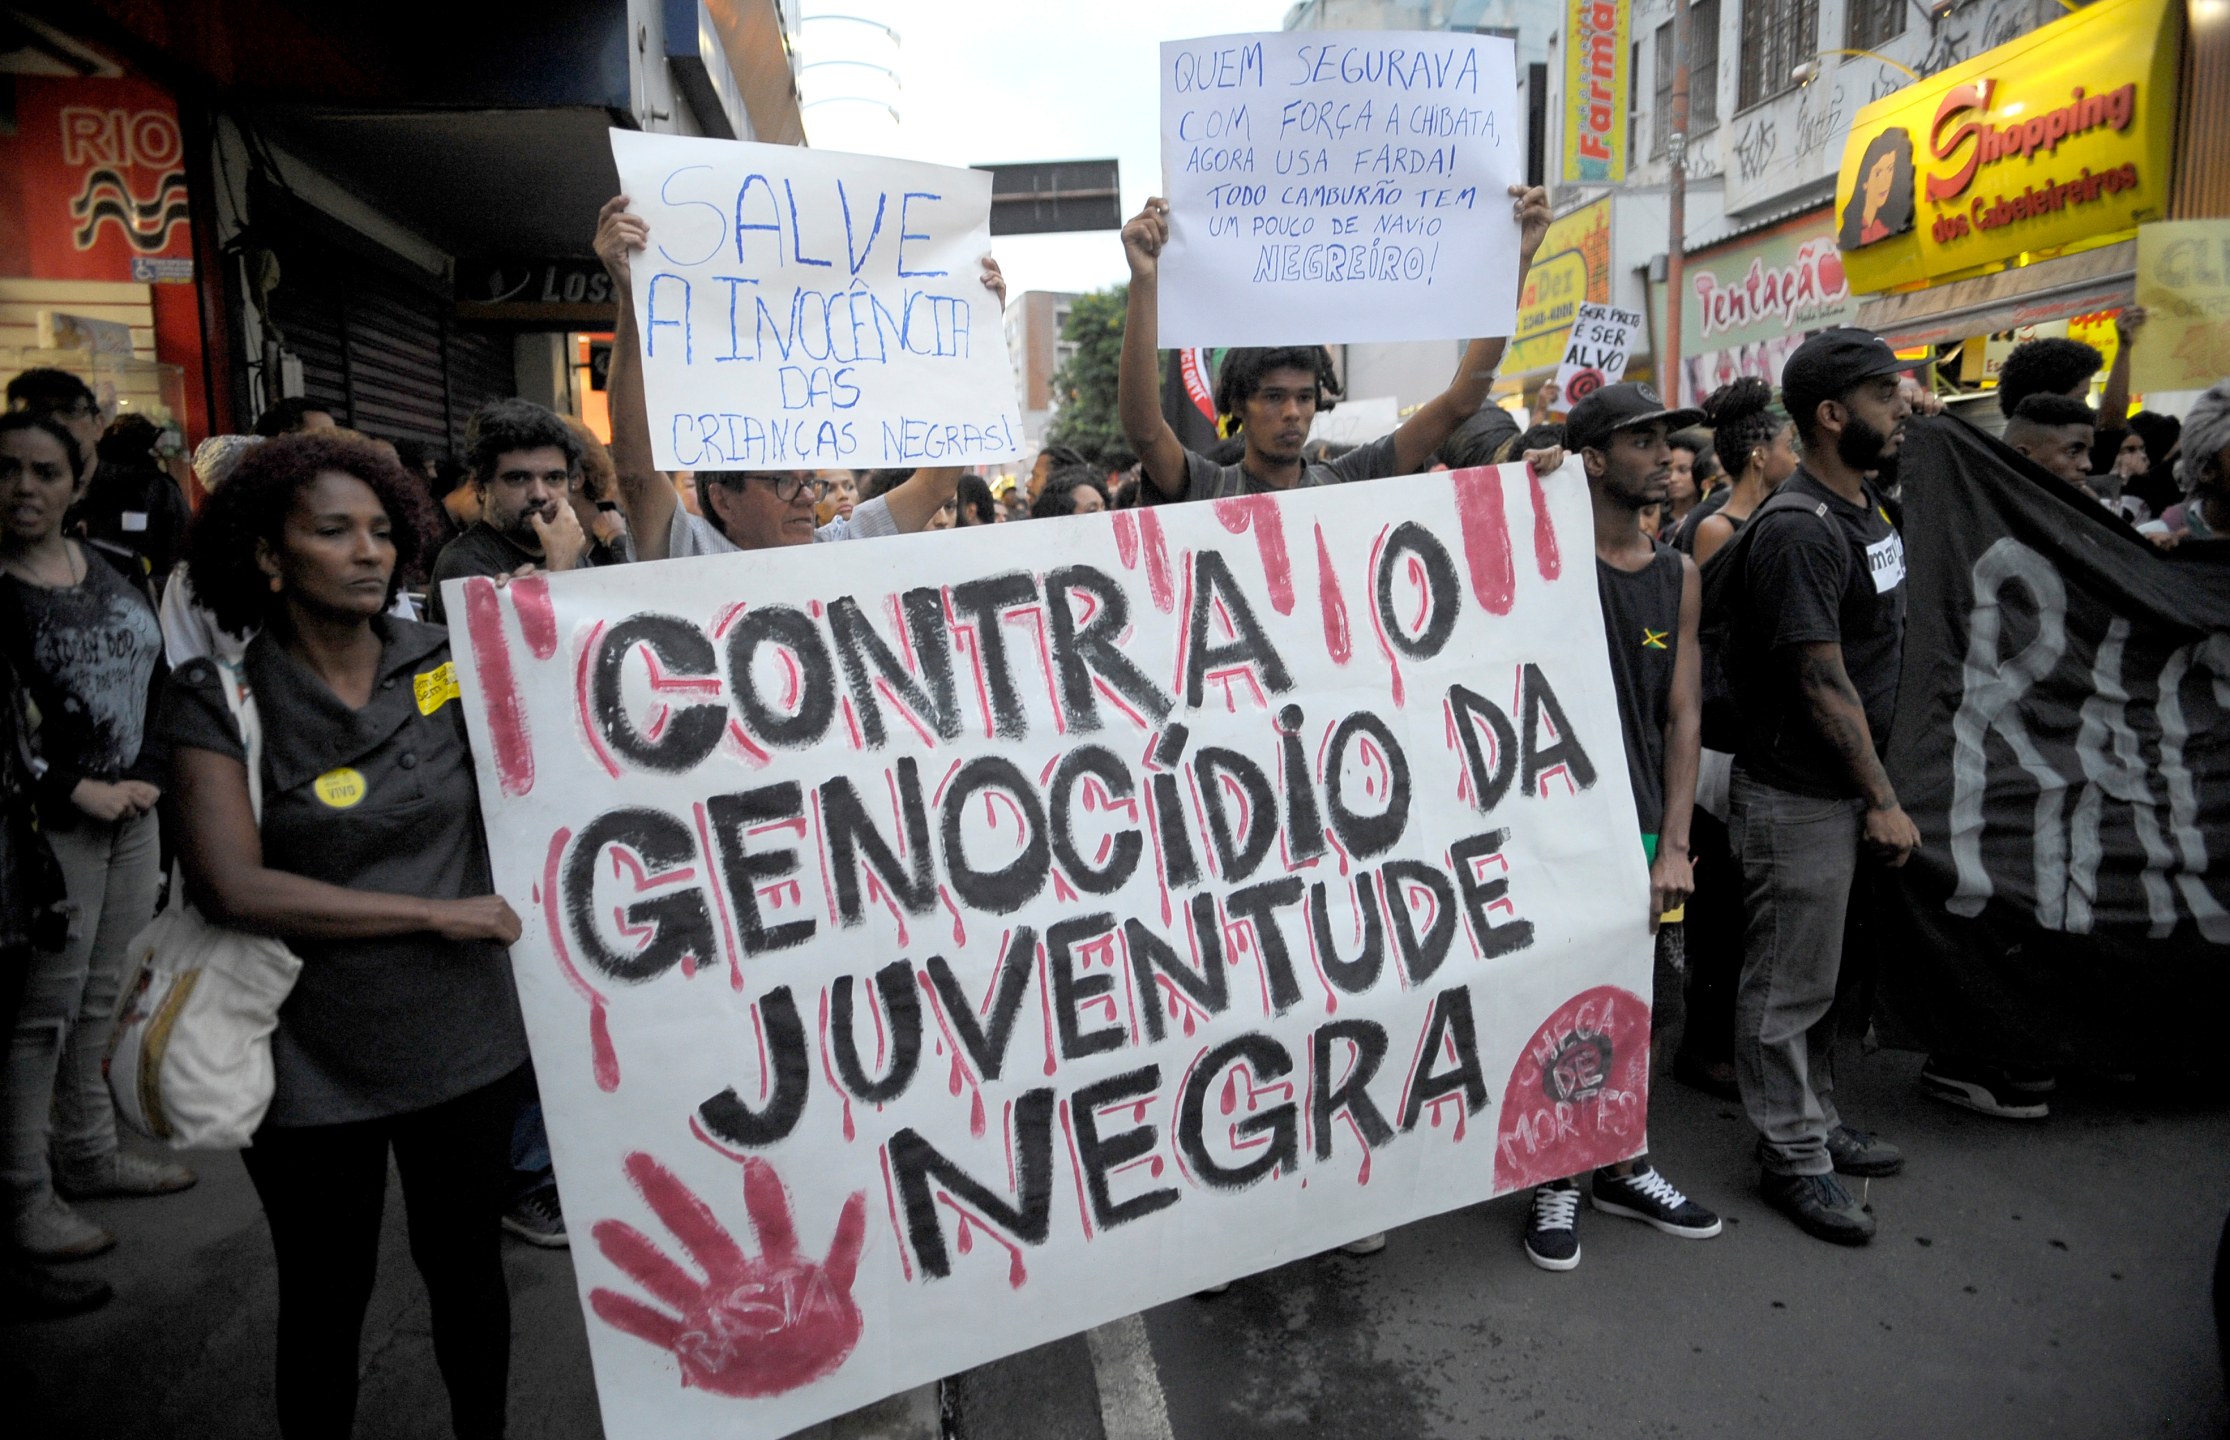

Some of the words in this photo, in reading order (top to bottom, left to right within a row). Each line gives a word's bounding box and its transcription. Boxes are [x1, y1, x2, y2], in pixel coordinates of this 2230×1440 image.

[1174, 41, 1263, 93] QUEM
[1289, 44, 1478, 94] SEGURAVA
[1579, 1, 1617, 161] Farma
[60, 106, 184, 170] RIO
[1179, 103, 1252, 143] COM
[1279, 99, 1373, 141] FORÇA
[1385, 105, 1400, 136] A
[1926, 79, 2136, 203] Shopping
[1186, 146, 1254, 172] AGORA
[1276, 148, 1328, 175] USA
[1354, 143, 1456, 178] FARDA!
[658, 165, 949, 277] SALVE
[1206, 182, 1268, 209] TODO
[1281, 179, 1401, 206] CAMBURÃO
[1415, 185, 1477, 210] TEM
[1931, 213, 1970, 244] dos
[1971, 161, 2137, 233] Cabeleireiros
[1208, 216, 1239, 237] UM
[1253, 216, 1315, 236] POUCO
[1332, 215, 1358, 235] DE
[541, 265, 621, 303] LOS
[647, 273, 692, 366] A
[712, 276, 970, 365] INOCÊNCIA
[1574, 316, 1586, 338] É
[1590, 324, 1627, 347] SER
[1579, 304, 1607, 321] SER
[1609, 307, 1642, 329] PRETO
[1565, 344, 1625, 373] ALVO
[778, 366, 861, 413] DAS
[672, 413, 858, 465] CRIANÇAS
[882, 414, 1018, 464] NEGRAS!
[597, 550, 1296, 775] CONTRA
[1377, 520, 1462, 662] O
[1445, 662, 1599, 815] DA
[699, 827, 1536, 1150] JUVENTUDE
[1517, 997, 1616, 1087] CHEGA
[1552, 1050, 1605, 1100] DE
[887, 985, 1492, 1285] NEGRA
[1500, 1086, 1638, 1170] MORTES
